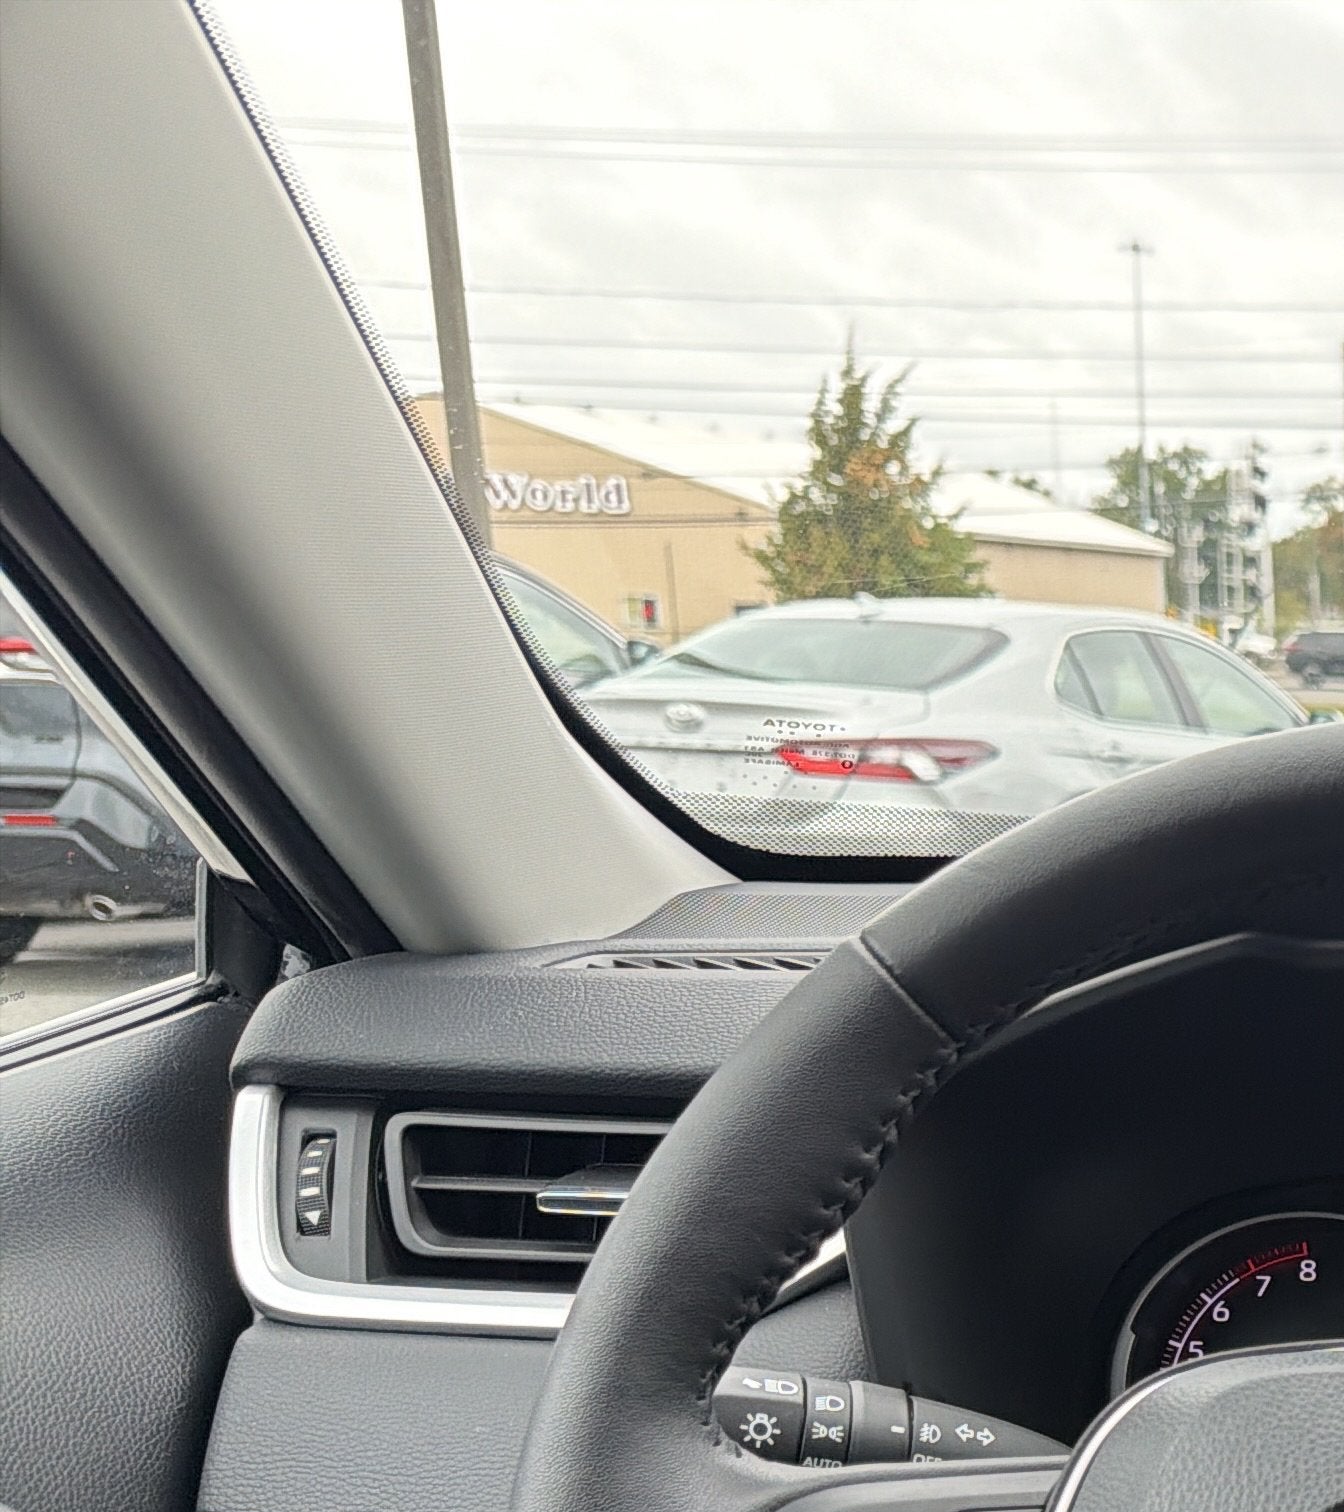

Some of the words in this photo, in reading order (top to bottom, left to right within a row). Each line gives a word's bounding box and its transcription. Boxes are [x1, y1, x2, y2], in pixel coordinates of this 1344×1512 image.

[484, 472, 630, 514] World
[1299, 1259, 1317, 1282] 8
[1255, 1275, 1272, 1297] 7
[1212, 1300, 1230, 1322] 6
[1188, 1340, 1204, 1358] 5
